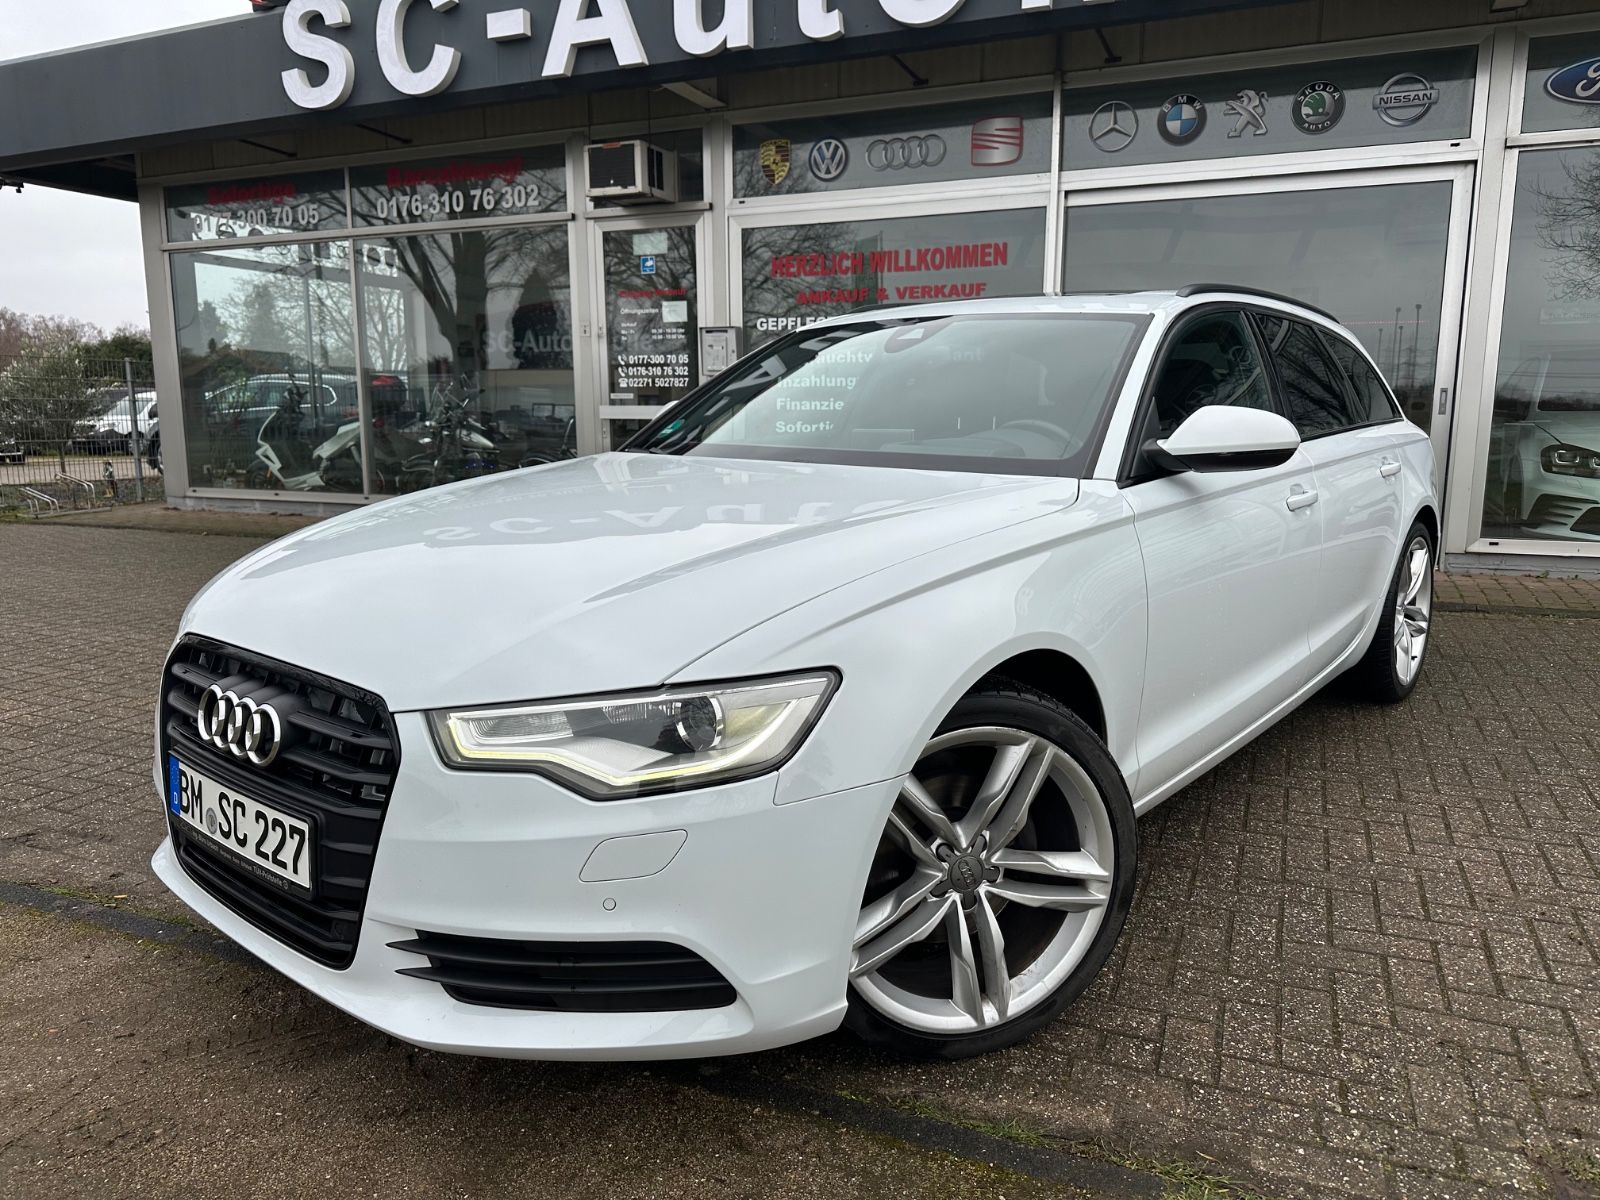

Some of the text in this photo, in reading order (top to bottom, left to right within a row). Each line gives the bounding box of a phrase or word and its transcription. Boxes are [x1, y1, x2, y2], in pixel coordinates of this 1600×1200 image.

[1162, 95, 1203, 113] BMW
[1379, 92, 1432, 105] NISSAN
[1303, 121, 1331, 130] AUTO
[376, 184, 540, 219] 0176-310 76 302
[271, 207, 293, 227] 70
[297, 204, 319, 225] 05
[770, 241, 1009, 279] HERZLICH WILLKOMMEN
[795, 282, 987, 306] ANKAUF & VERKAUF
[628, 355, 689, 365] 0177-300 70 05
[628, 367, 689, 376] 0176-310 76 302
[628, 377, 689, 388] 02271 5027827
[173, 791, 178, 805] D
[180, 767, 203, 825] BM
[218, 791, 247, 848] SC
[254, 809, 306, 876] 227
